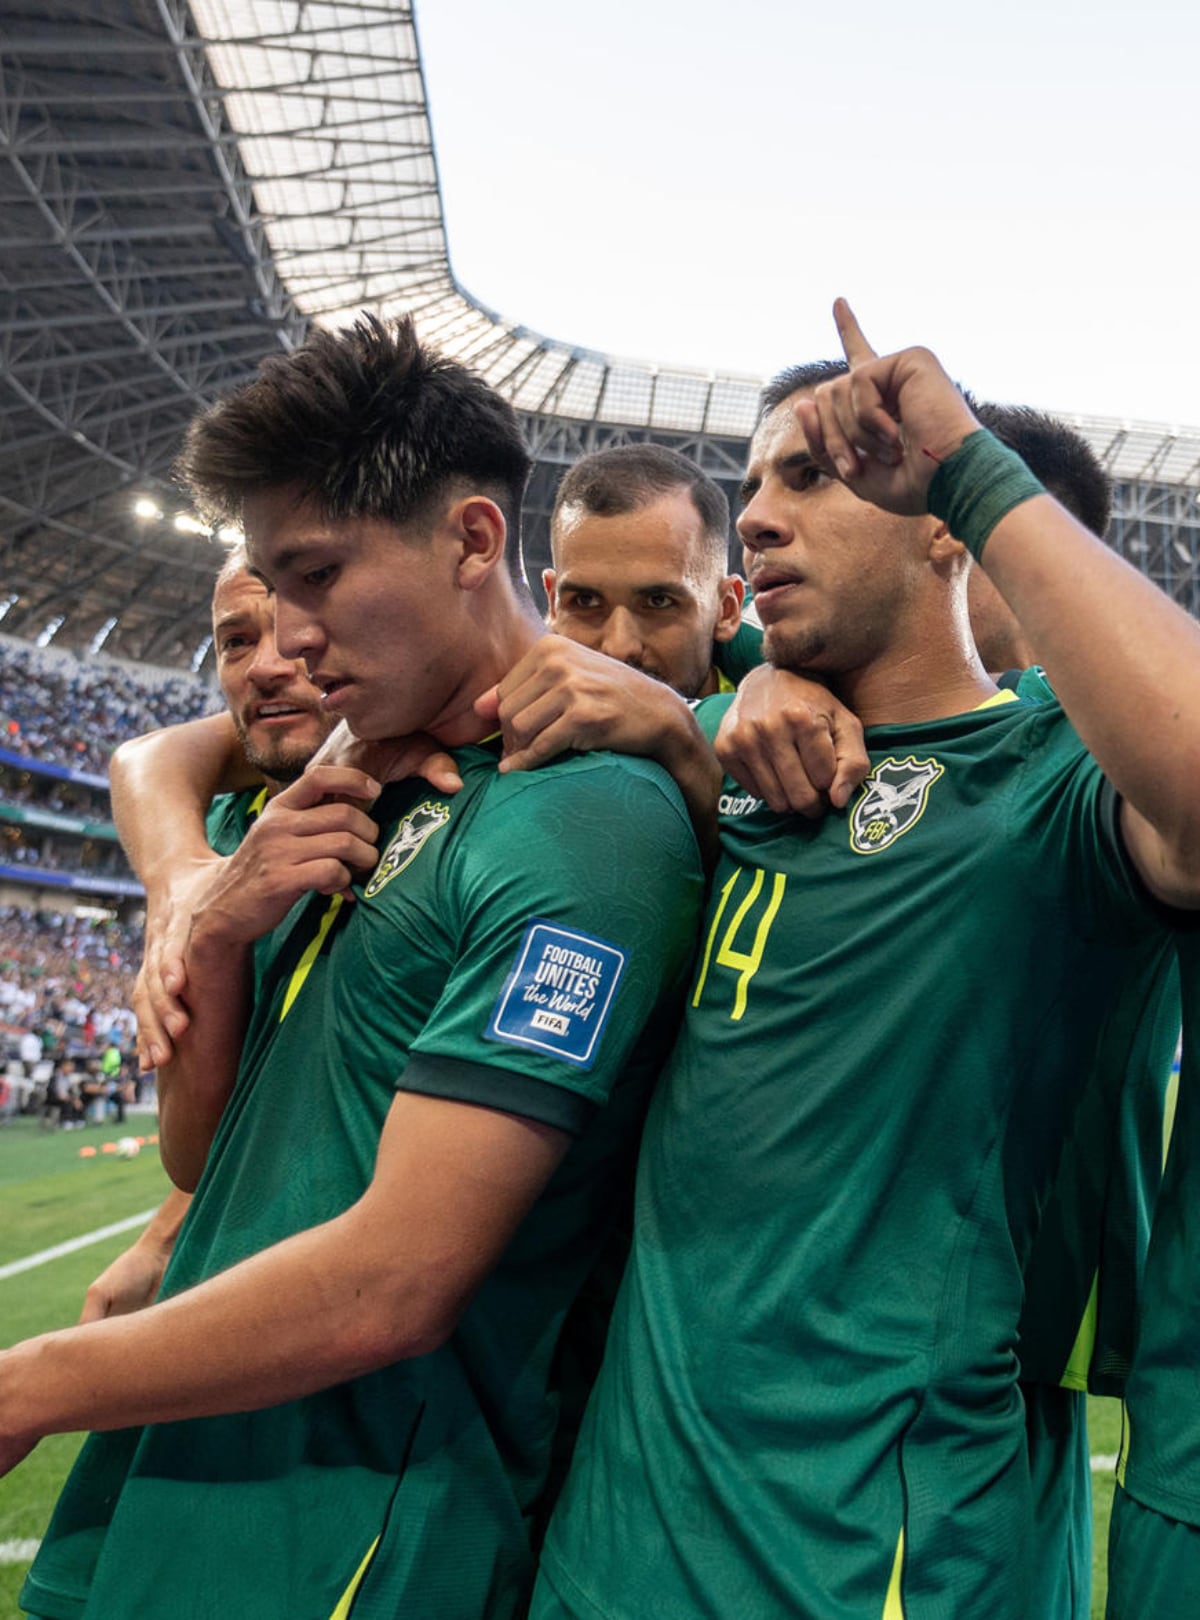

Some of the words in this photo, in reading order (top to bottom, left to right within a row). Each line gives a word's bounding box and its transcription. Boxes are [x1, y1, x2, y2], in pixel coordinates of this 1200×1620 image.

[542, 944, 603, 978] FOOTBALL
[692, 866, 787, 1021] 14
[534, 961, 600, 999] UNITES
[523, 984, 549, 1005] the
[550, 990, 595, 1021] World
[537, 1014, 563, 1031] FIFA
